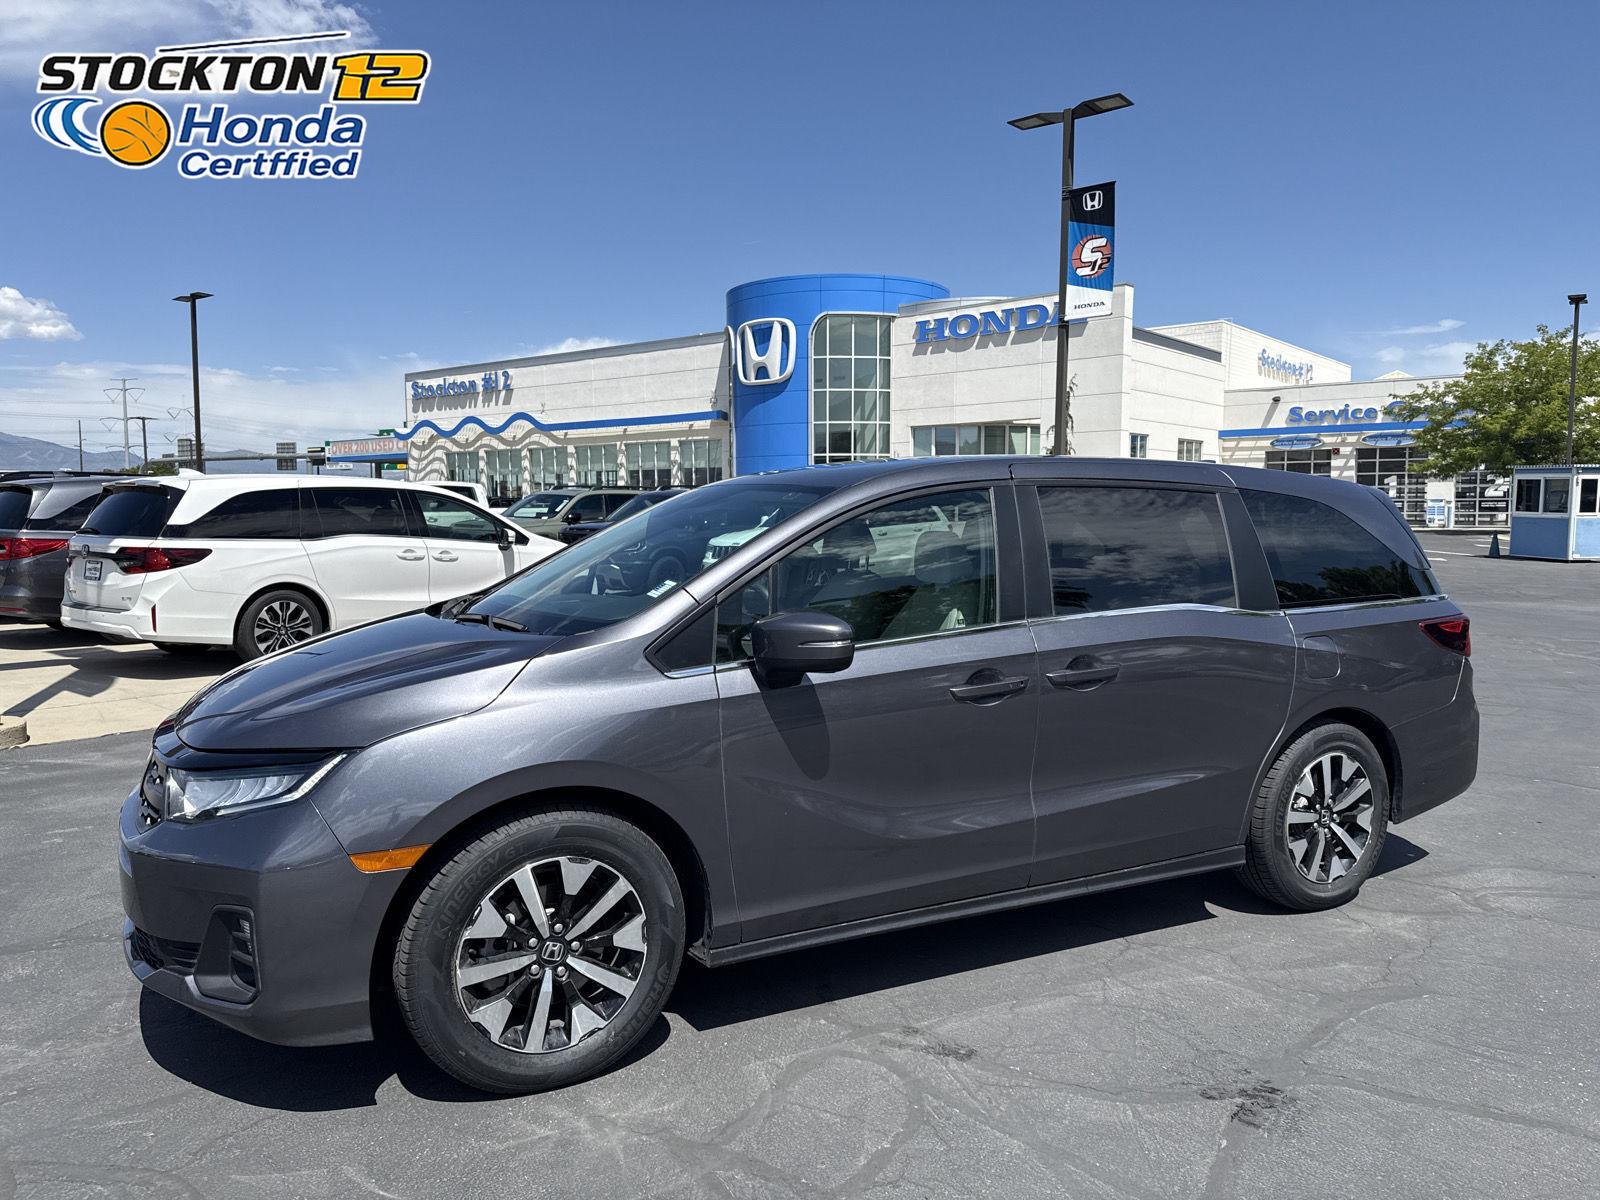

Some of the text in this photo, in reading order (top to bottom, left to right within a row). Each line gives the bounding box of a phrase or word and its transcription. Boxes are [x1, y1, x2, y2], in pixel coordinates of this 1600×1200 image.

[1073, 301, 1106, 310] HONDA
[411, 370, 511, 400] Stockton #12
[1288, 403, 1378, 425] Service
[331, 442, 353, 455] OVER
[354, 440, 370, 453] 200
[371, 439, 395, 452] USED
